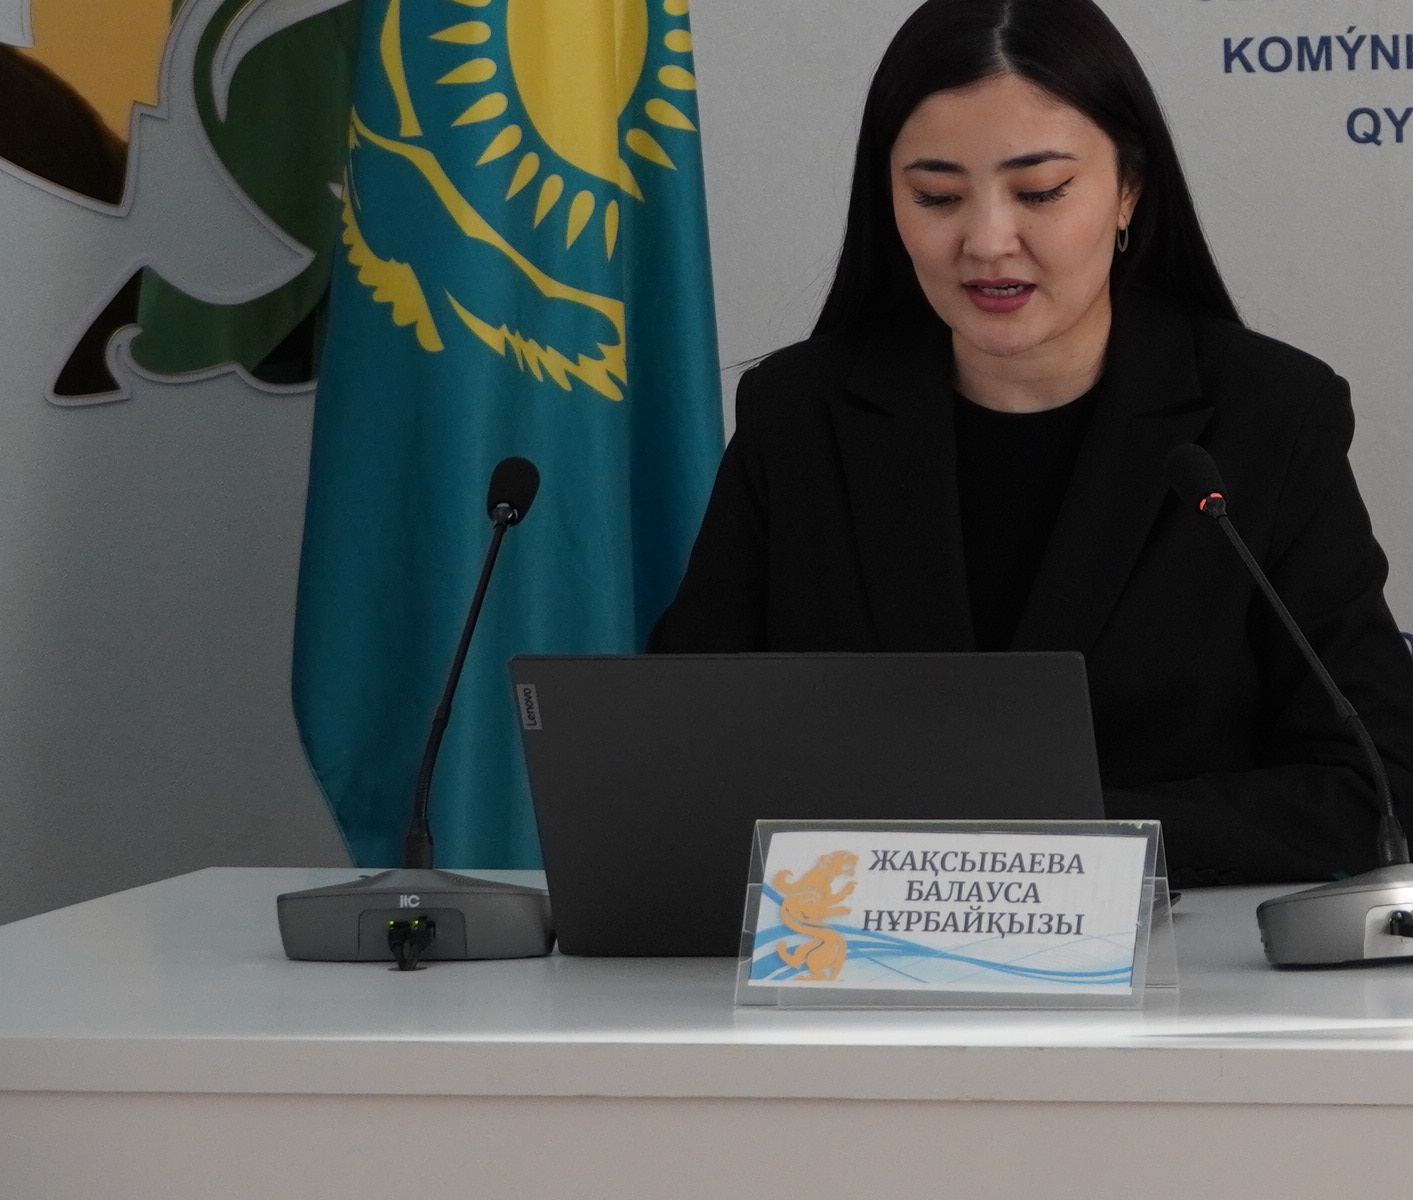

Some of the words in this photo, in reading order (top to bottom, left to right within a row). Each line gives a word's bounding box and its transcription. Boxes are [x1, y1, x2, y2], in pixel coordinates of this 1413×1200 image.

[522, 686, 538, 727] Lenovo
[866, 848, 1086, 878] ЖАҚСЫБАЕВА
[904, 879, 1042, 904] БАЛАУСА
[861, 905, 1086, 939] НҰРБАЙҚЫЗЫ
